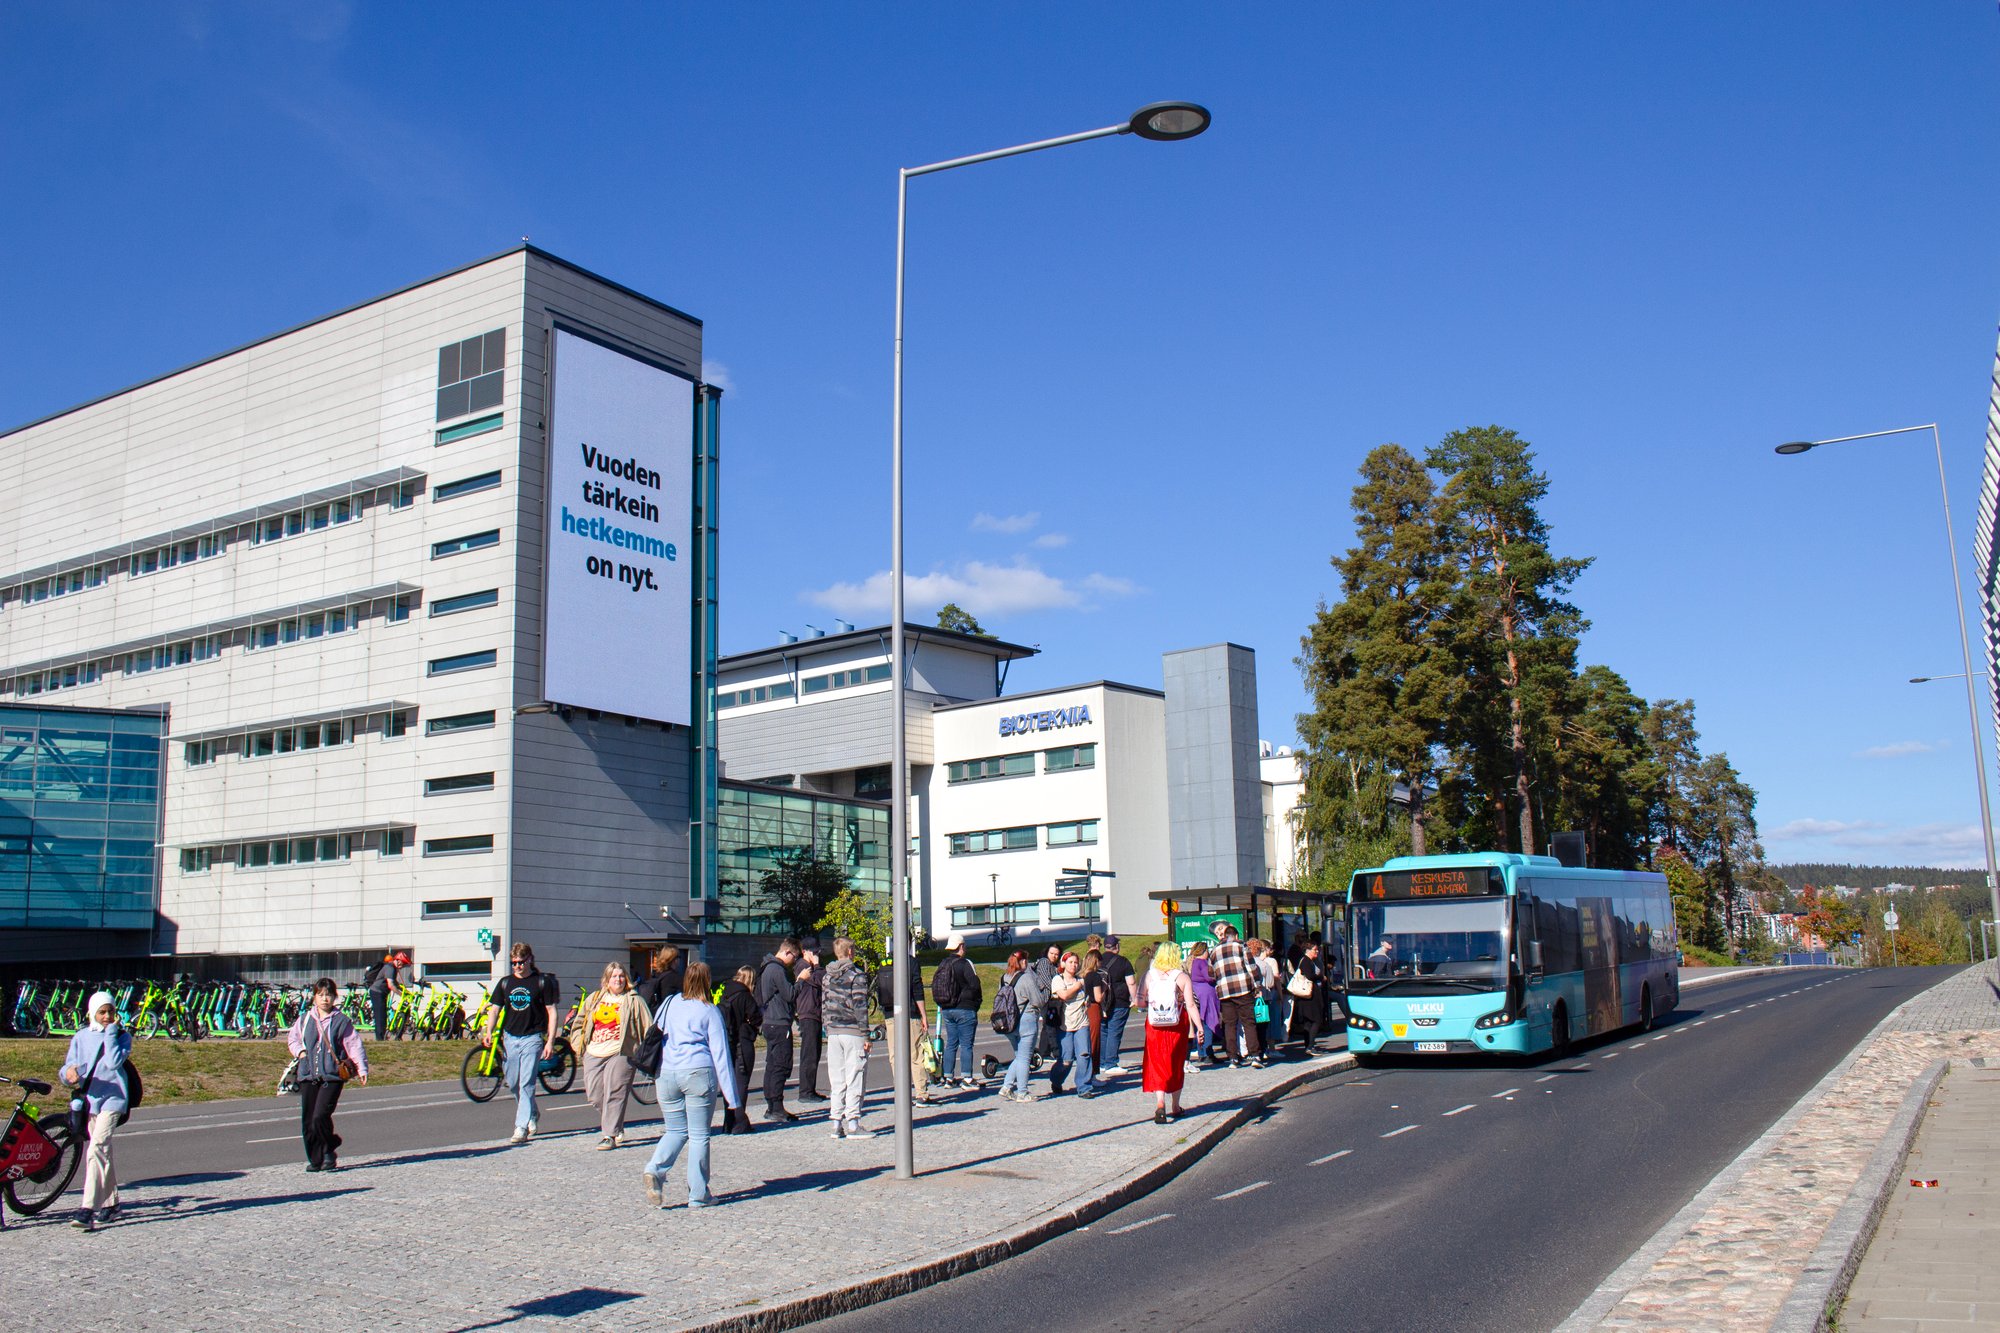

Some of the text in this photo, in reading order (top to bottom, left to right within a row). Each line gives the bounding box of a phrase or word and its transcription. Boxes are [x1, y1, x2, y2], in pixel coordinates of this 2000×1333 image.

[581, 443, 661, 490] Vuoden
[582, 480, 659, 523] tärkein
[561, 506, 677, 561] hetkemme
[586, 556, 659, 592] on nyt.
[999, 704, 1091, 736] BIOTEKNIA
[1372, 871, 1465, 898] 4 KESKUSTA
[1407, 1003, 1444, 1012] VILKKU
